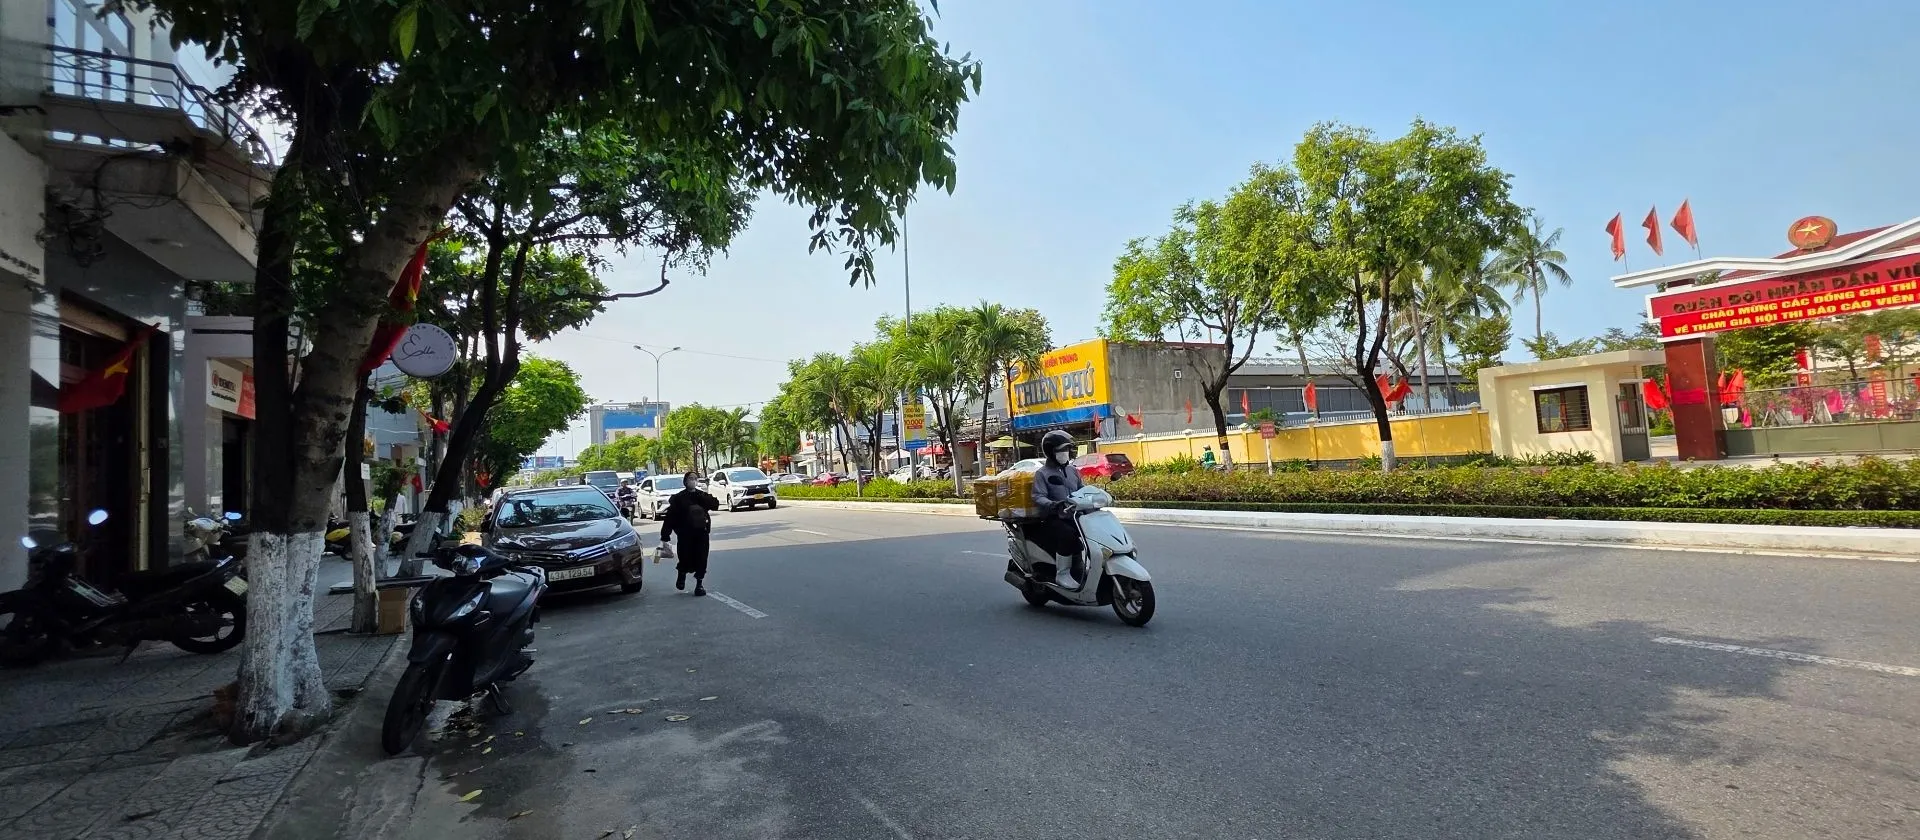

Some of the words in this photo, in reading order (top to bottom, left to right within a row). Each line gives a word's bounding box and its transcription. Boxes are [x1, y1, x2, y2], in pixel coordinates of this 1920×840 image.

[1832, 271, 1879, 288] DÂN
[1692, 320, 1726, 332] THAM
[1730, 317, 1752, 327] GIA
[1755, 313, 1778, 323] HỘI
[1781, 310, 1803, 320] THI
[1807, 305, 1837, 316] BÁO
[1840, 300, 1872, 311] CÁO
[1876, 294, 1914, 306] VIÊN
[1701, 309, 1735, 320] CHÀO
[1738, 302, 1778, 315] MỪNG
[1781, 298, 1810, 309] CÁC
[1813, 291, 1855, 304] ĐỒNG
[1859, 284, 1887, 297] CHÍ
[1061, 360, 1095, 400] PHÚ
